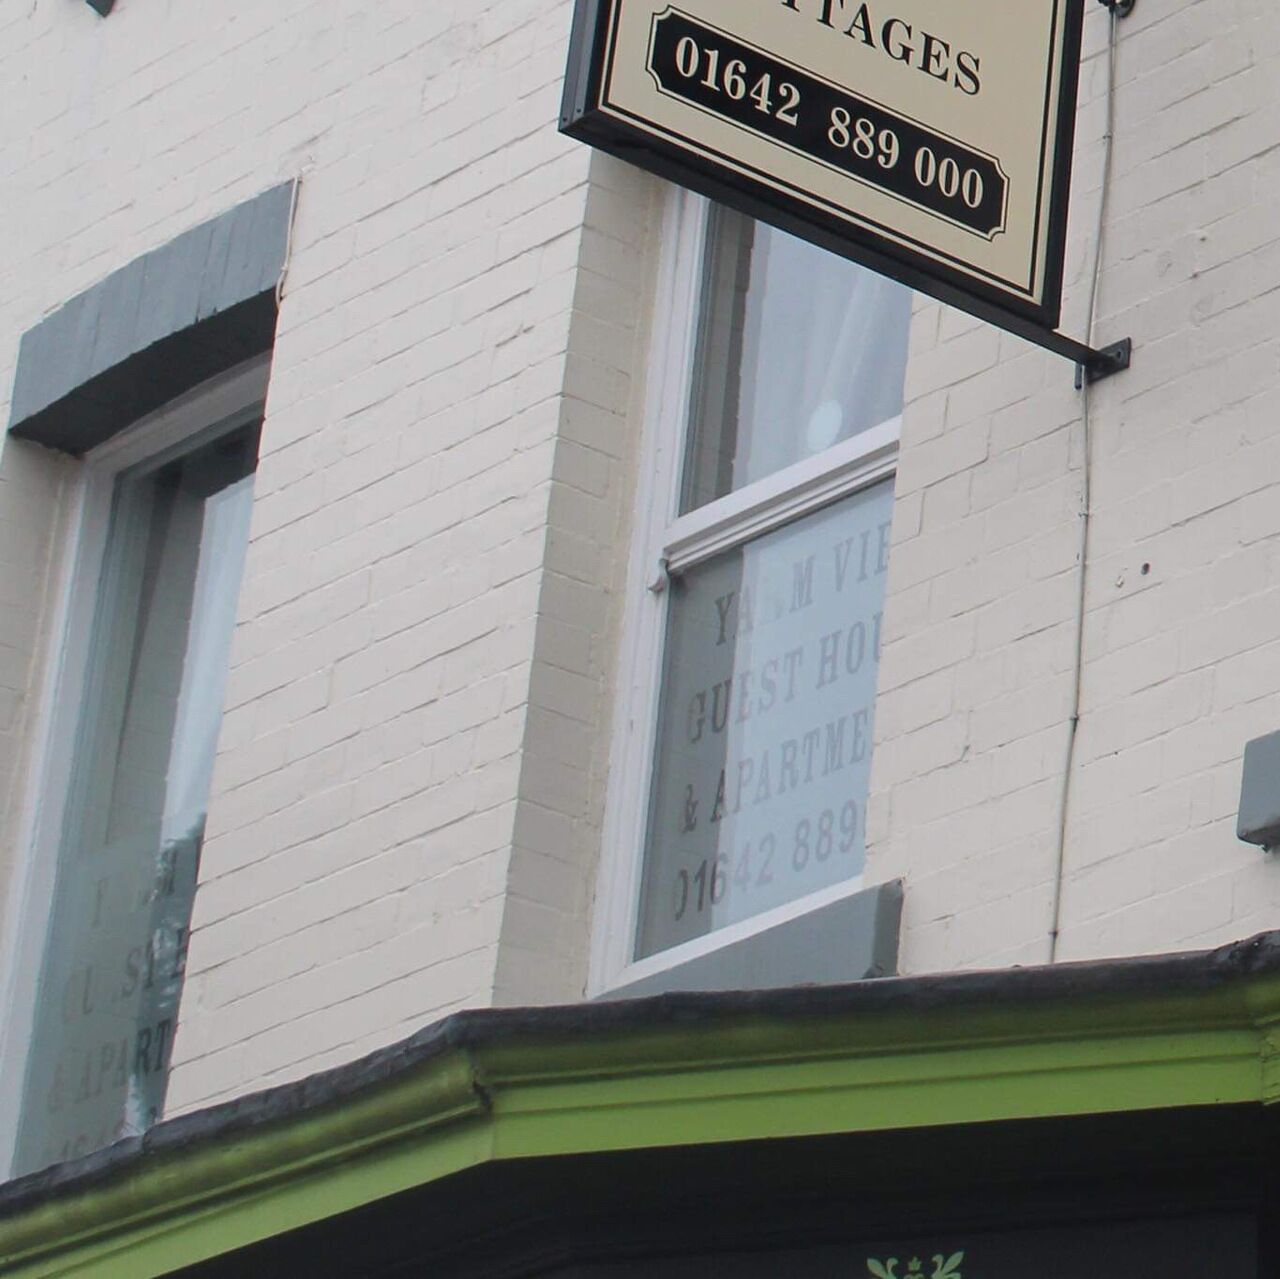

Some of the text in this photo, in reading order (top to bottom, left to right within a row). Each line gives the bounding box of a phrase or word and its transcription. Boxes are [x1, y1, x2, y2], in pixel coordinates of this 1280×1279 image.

[675, 36, 984, 209] 01642 889 000
